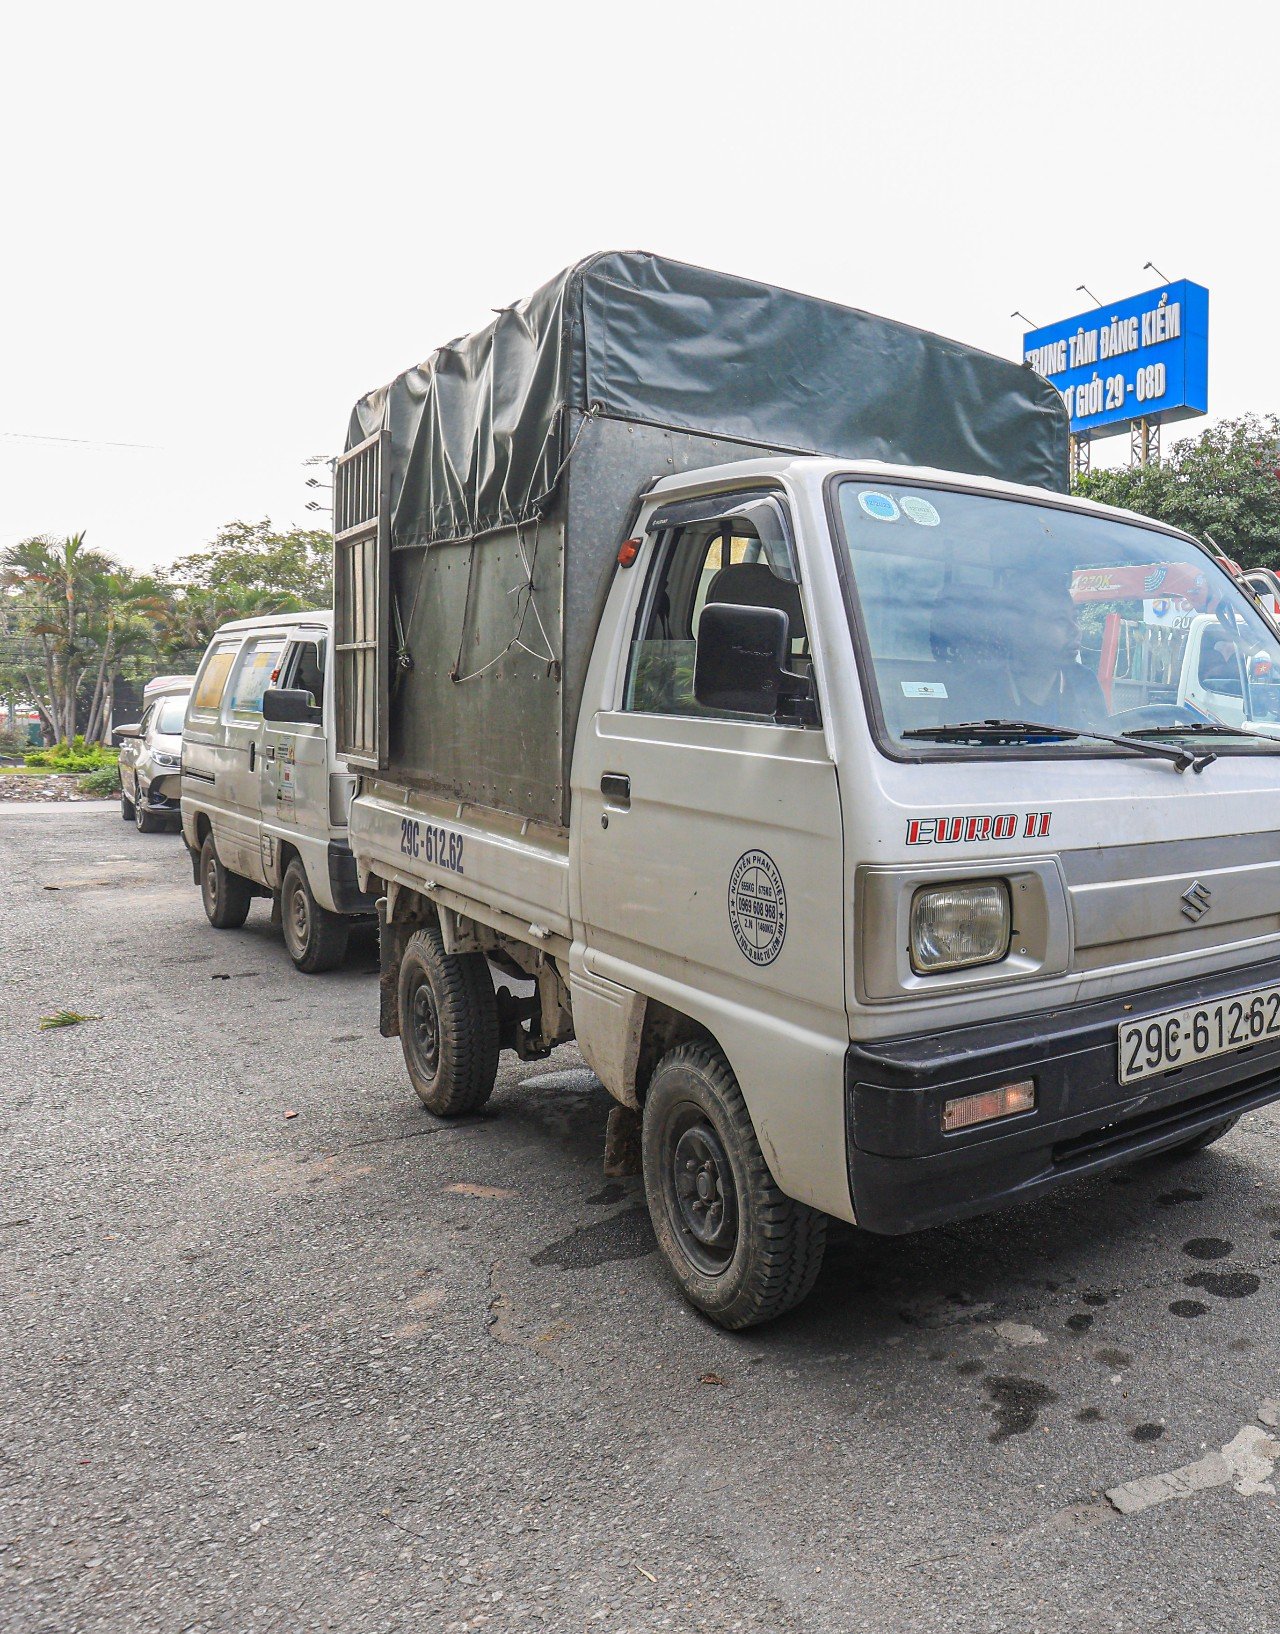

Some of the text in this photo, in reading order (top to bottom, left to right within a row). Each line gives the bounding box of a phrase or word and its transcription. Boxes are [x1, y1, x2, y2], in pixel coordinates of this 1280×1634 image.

[1069, 327, 1098, 369] TÂM
[1100, 315, 1138, 359] ĐĂNG
[1142, 292, 1181, 347] KIỂM
[1060, 363, 1166, 420] Ơ GIỚI 29 - 08D
[401, 818, 464, 875] 29C-612.62
[905, 812, 1052, 846] EURO II
[752, 855, 771, 872] PHAN
[1125, 992, 1280, 1077] 29C-612.62
